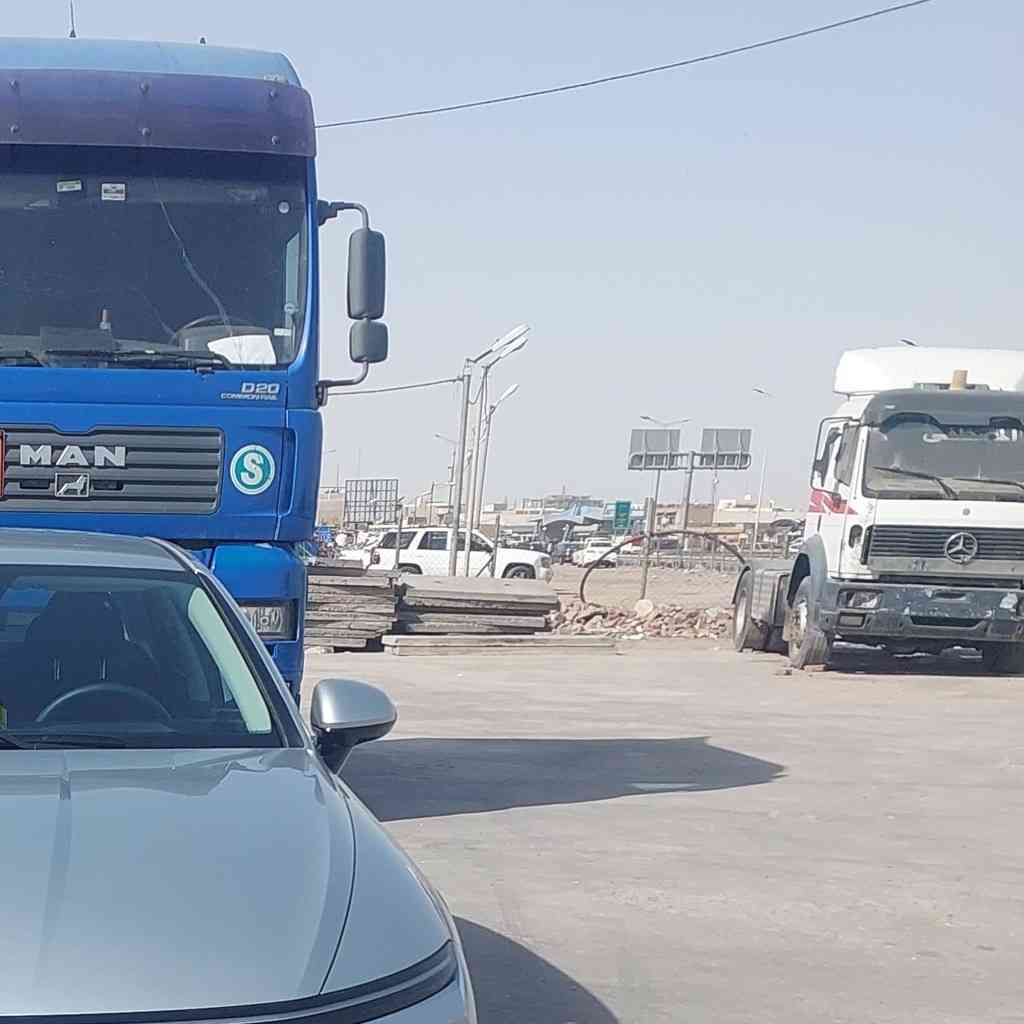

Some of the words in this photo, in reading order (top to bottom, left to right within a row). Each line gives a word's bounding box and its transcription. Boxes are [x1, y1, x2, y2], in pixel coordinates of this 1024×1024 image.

[241, 382, 280, 394] D20
[19, 444, 126, 466] MAN
[240, 452, 264, 486] S
